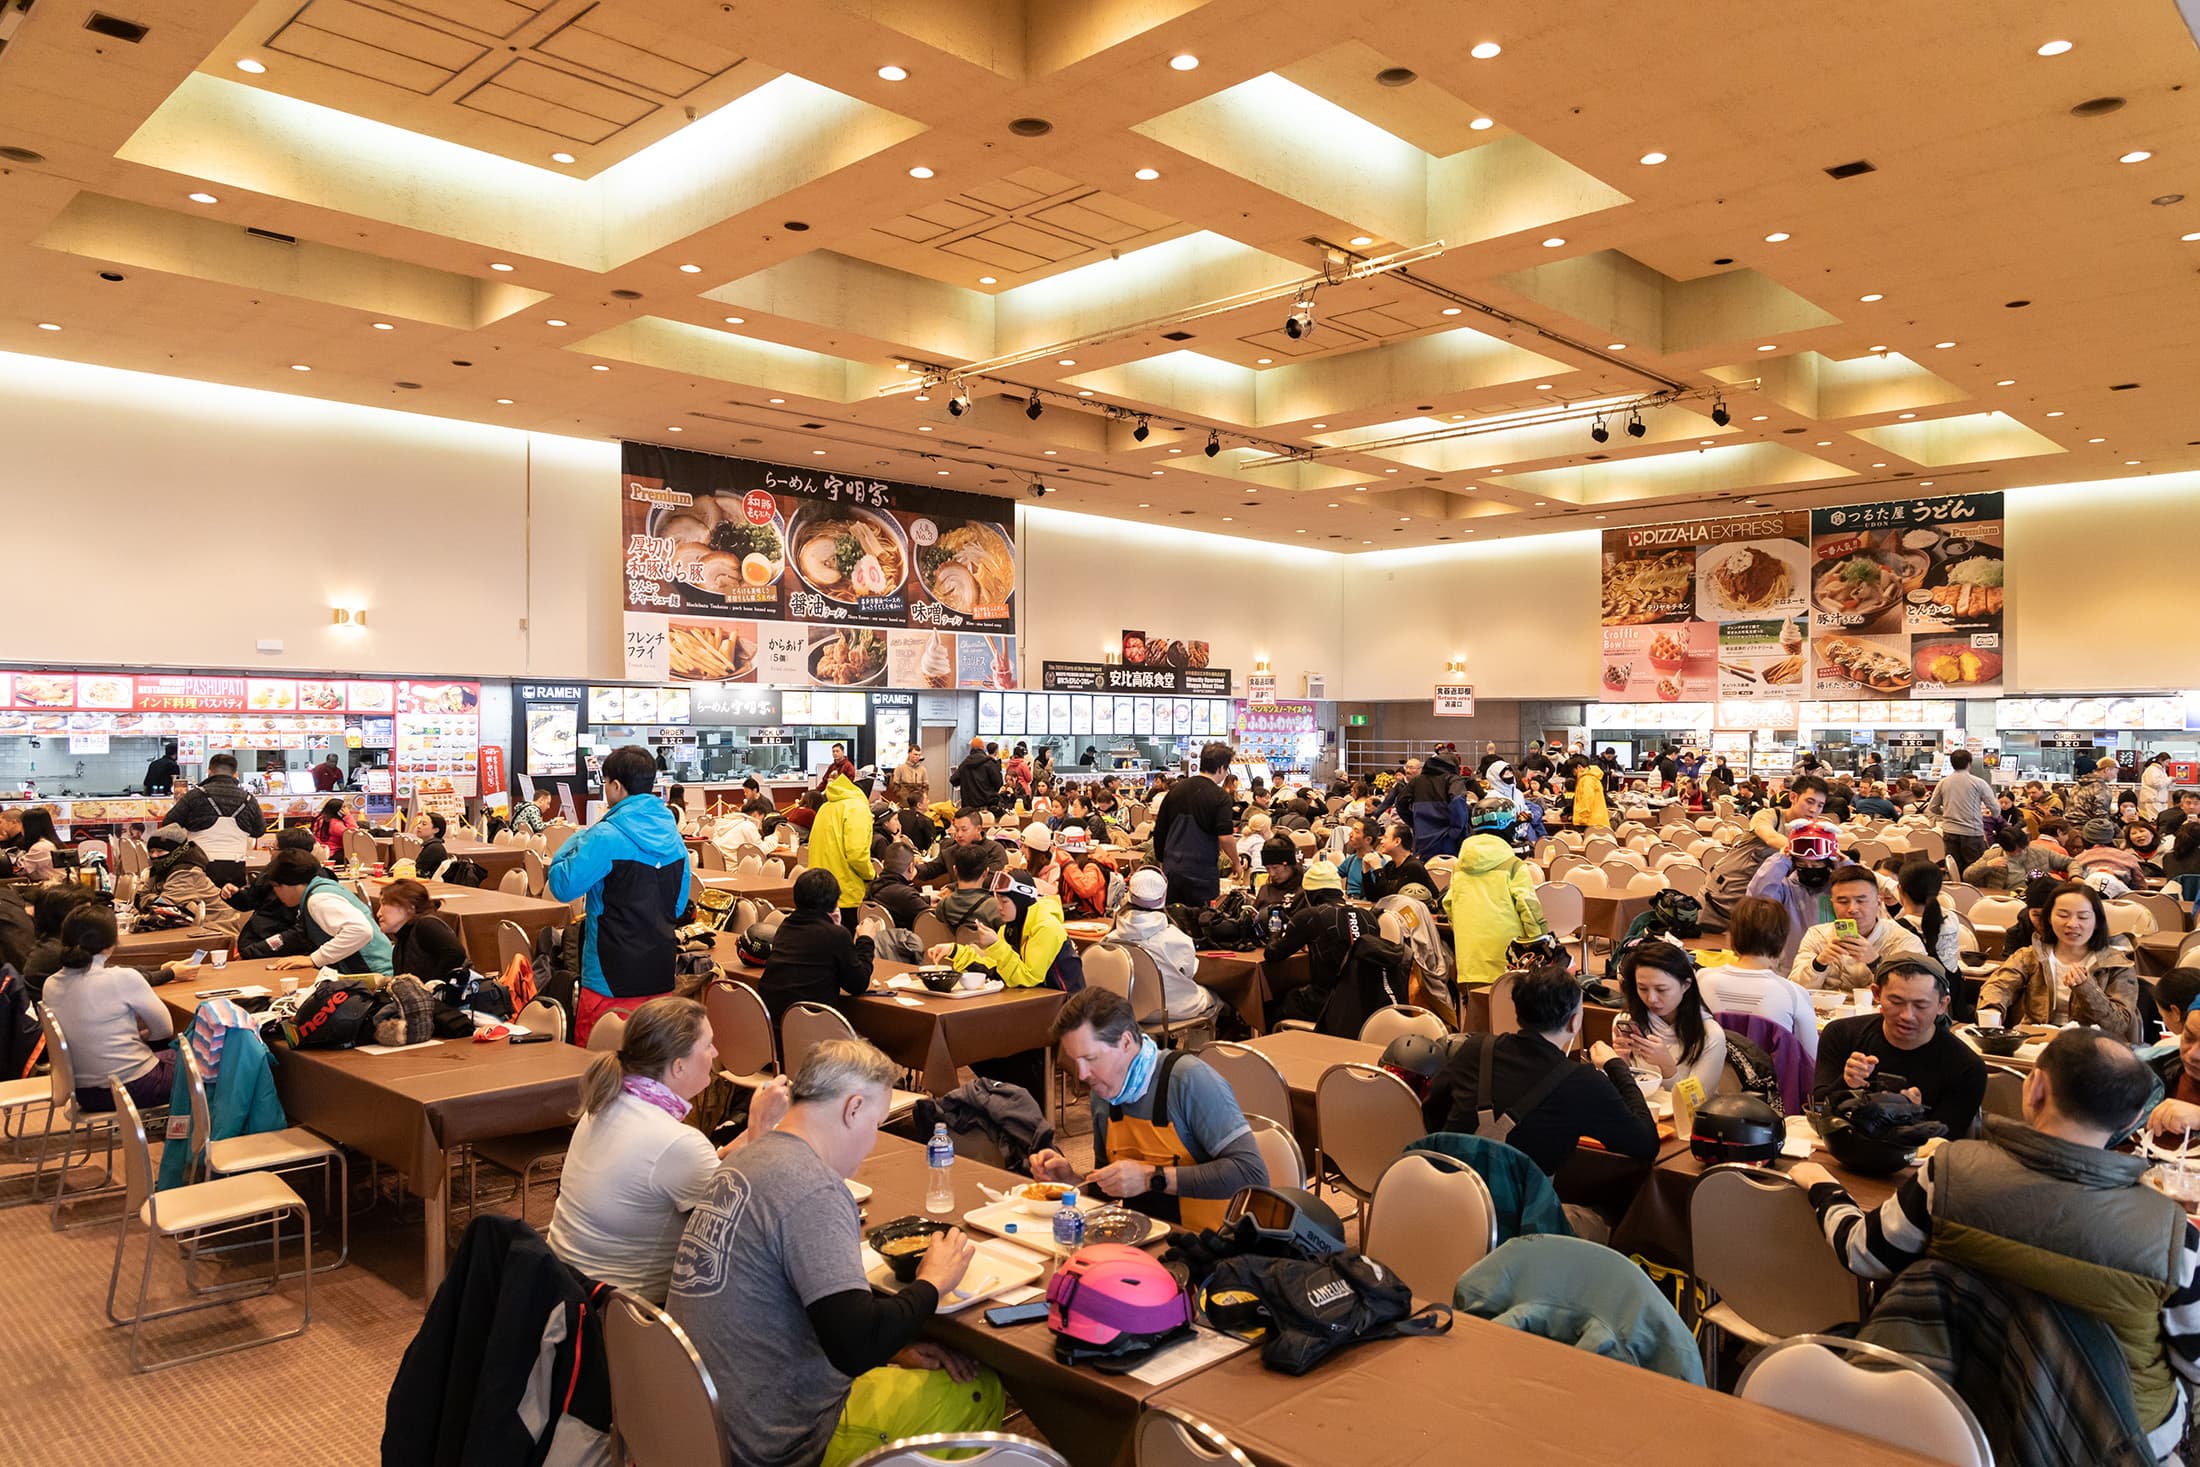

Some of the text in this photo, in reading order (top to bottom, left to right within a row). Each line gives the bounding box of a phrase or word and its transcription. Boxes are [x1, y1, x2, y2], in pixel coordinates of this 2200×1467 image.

[765, 471, 818, 493] らーめん
[631, 484, 693, 507] Premium
[1848, 499, 1975, 522] つるた屋 うどん
[1864, 520, 1889, 528] UDON
[915, 530, 934, 541] No.3
[1643, 519, 1784, 546] PIZZA-LA EXPRESS
[1951, 526, 1999, 538] Premium
[629, 535, 676, 560] 厚切り
[627, 557, 705, 584] 和豚もち豚
[629, 580, 661, 594] とんこつ
[790, 592, 825, 617] 醤油
[1646, 602, 1691, 612] テリヤキチキン
[1906, 605, 1952, 616] とんかつ
[911, 602, 943, 624] 味噌
[627, 631, 665, 646] フレンチ
[768, 638, 805, 652] からあげ
[1603, 640, 1626, 650] Bowl
[627, 646, 656, 660] フライ
[1109, 670, 1175, 689] 安比高原食堂
[1816, 681, 1863, 691] 揚げたこ焼き
[1916, 682, 1945, 691] 焼きいも
[185, 679, 244, 696] PASHUPATI
[536, 686, 582, 699] RAMEN
[139, 698, 198, 709] インド料理
[882, 694, 913, 704] RAMEN
[697, 703, 730, 713] らーめん
[660, 729, 685, 737] ORDER
[2053, 732, 2081, 740] ORDER
[298, 990, 349, 1038] neve
[1306, 1230, 1333, 1253] anon
